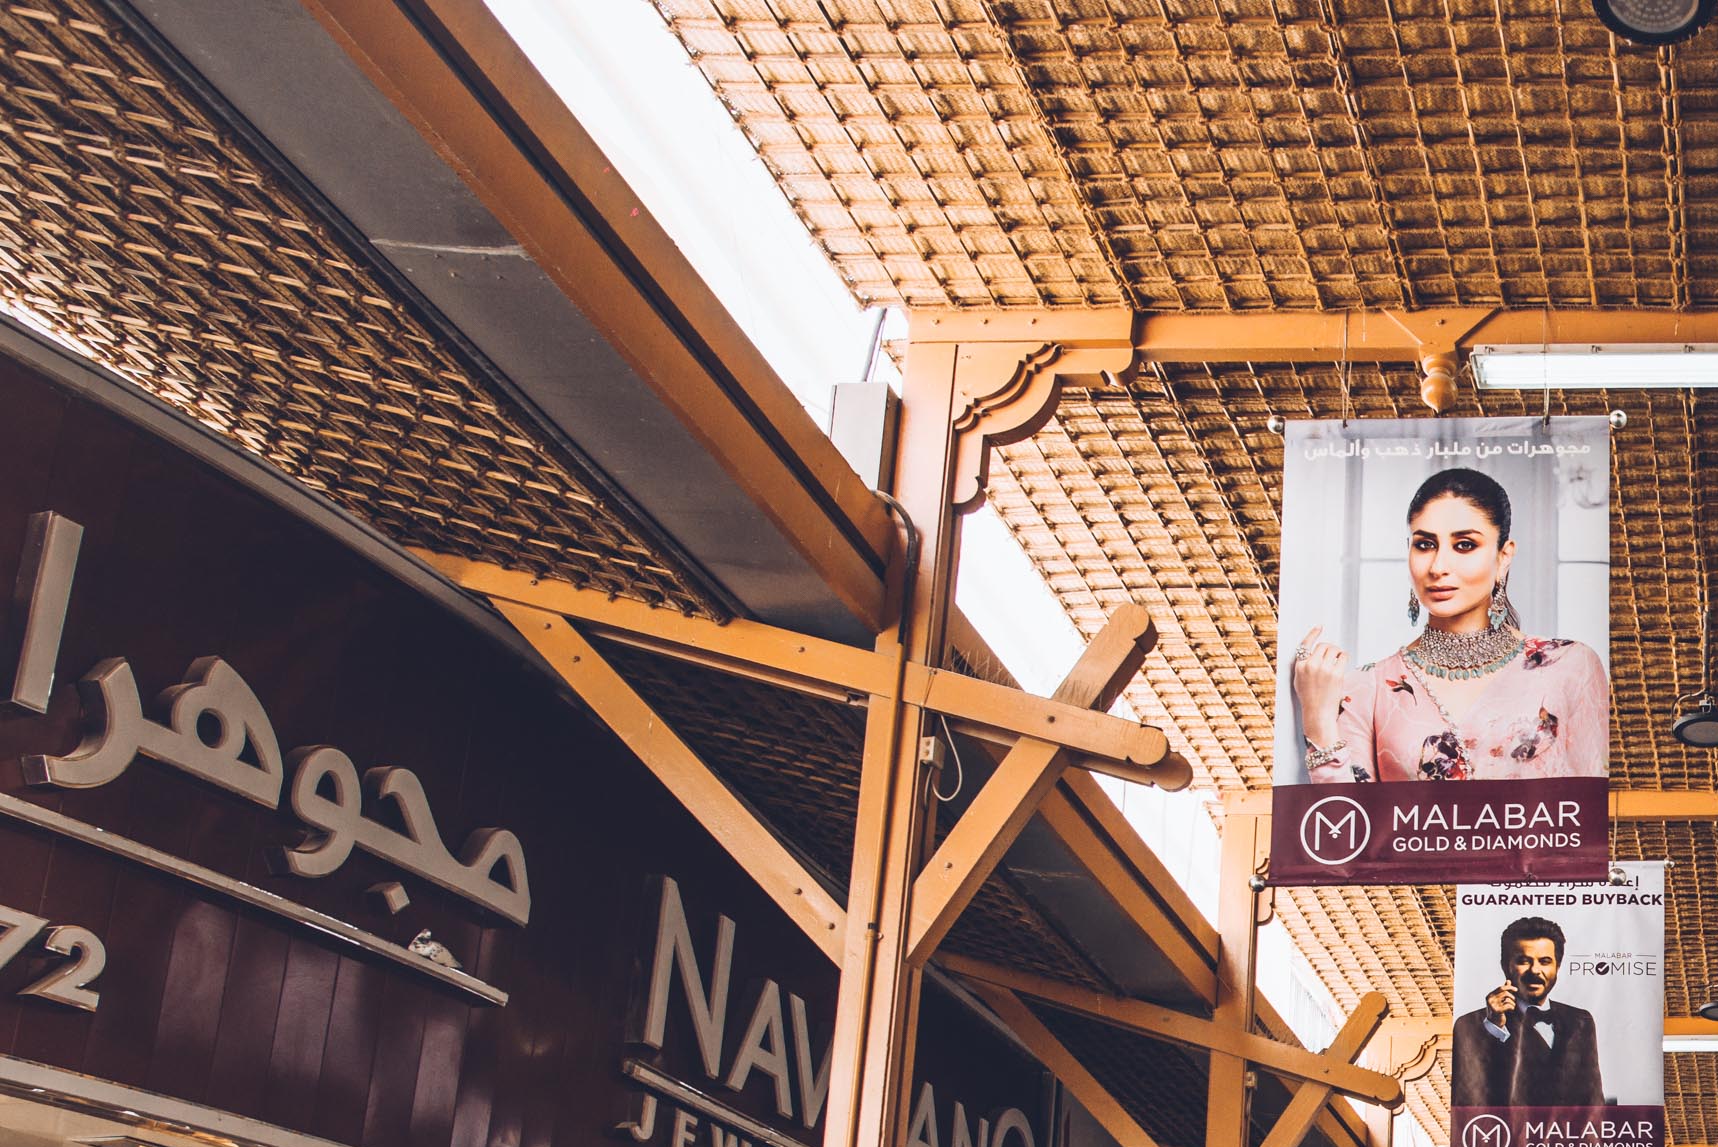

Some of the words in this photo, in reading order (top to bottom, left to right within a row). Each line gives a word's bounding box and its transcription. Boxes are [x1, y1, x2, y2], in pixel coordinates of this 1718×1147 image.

[1476, 442, 1503, 458] من
[1393, 801, 1581, 831] MALABAR
[1393, 836, 1450, 851] GOLD
[1454, 836, 1467, 851] &
[1472, 833, 1581, 850] DIAMONDS
[1462, 894, 1577, 906] GUARANTEED
[1582, 893, 1663, 906] BUYBACK
[1525, 1121, 1654, 1139] MALABAR
